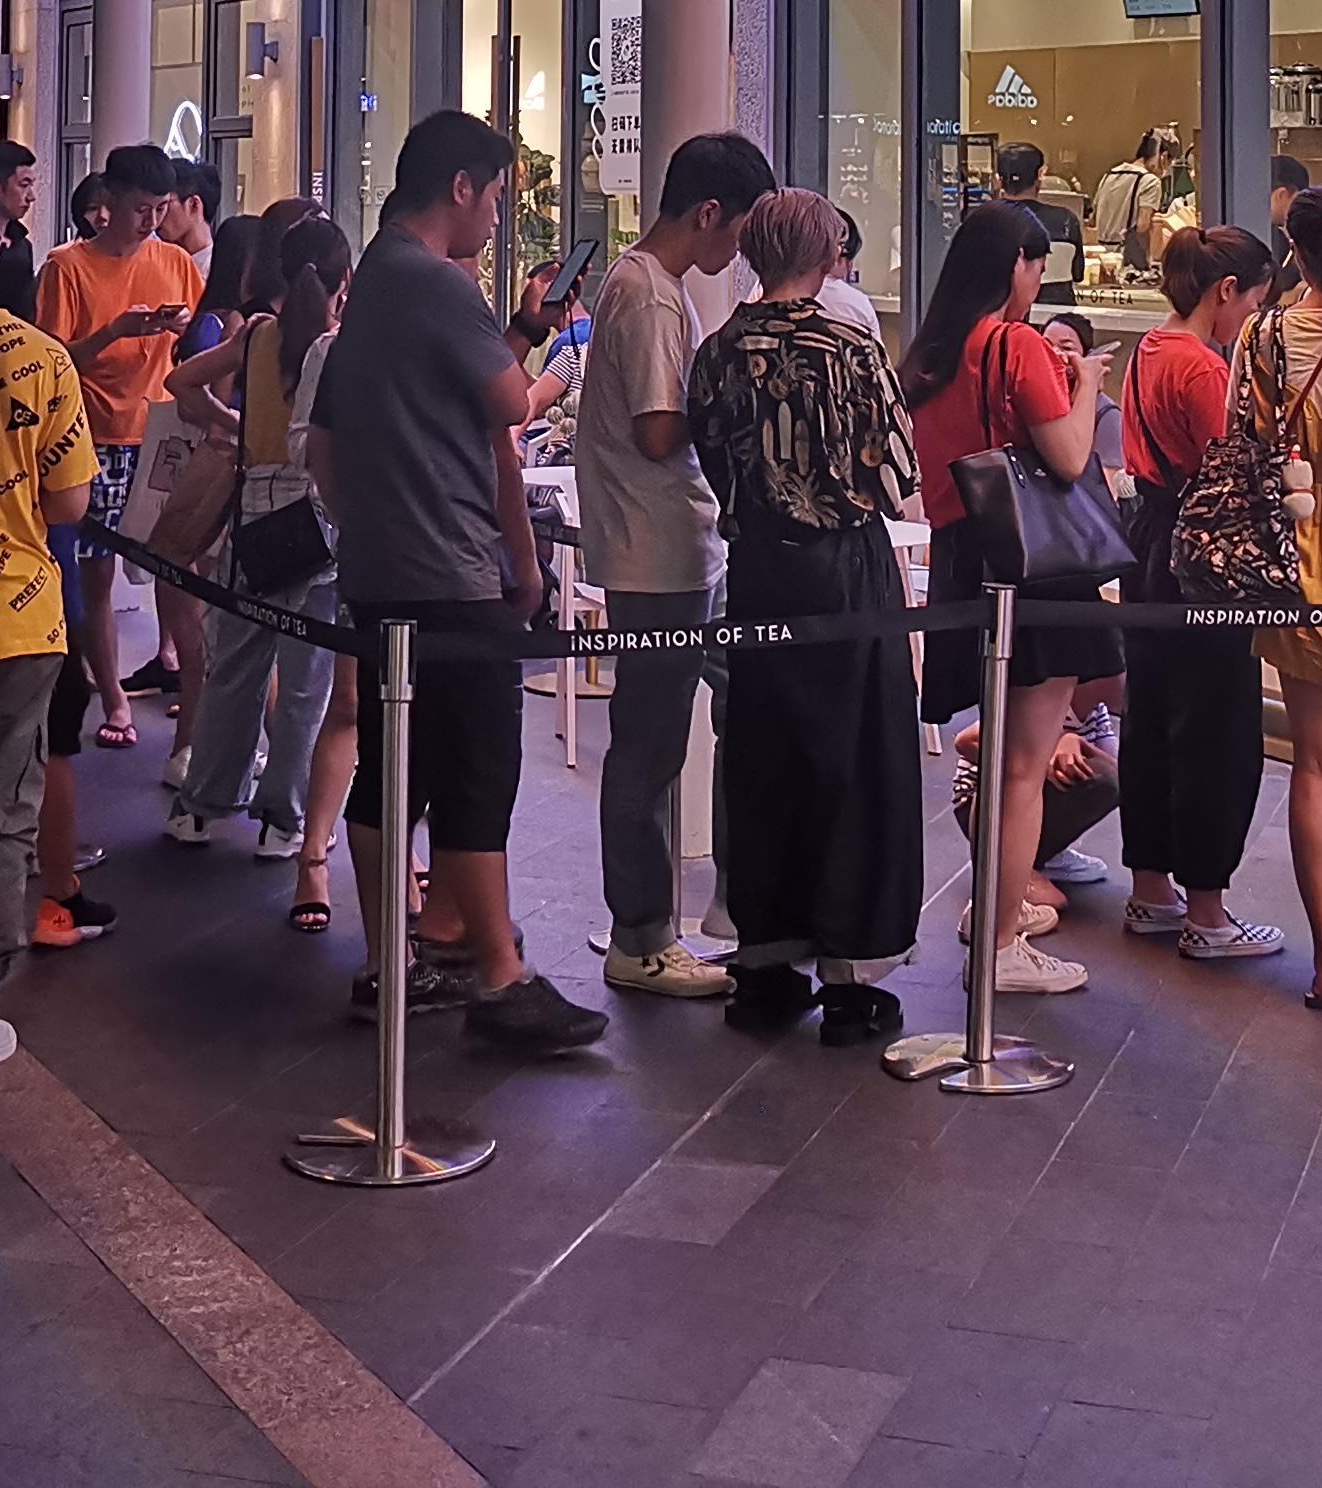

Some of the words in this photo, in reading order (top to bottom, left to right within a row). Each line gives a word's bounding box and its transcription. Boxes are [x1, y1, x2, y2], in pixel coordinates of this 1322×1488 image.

[313, 172, 324, 205] INSP
[1112, 291, 1133, 305] TEA
[11, 361, 45, 382] COOL
[1186, 609, 1300, 625] INSPIRATION
[570, 629, 704, 652] INSPIRATION
[716, 627, 743, 645] OF
[755, 624, 793, 642] TEA
